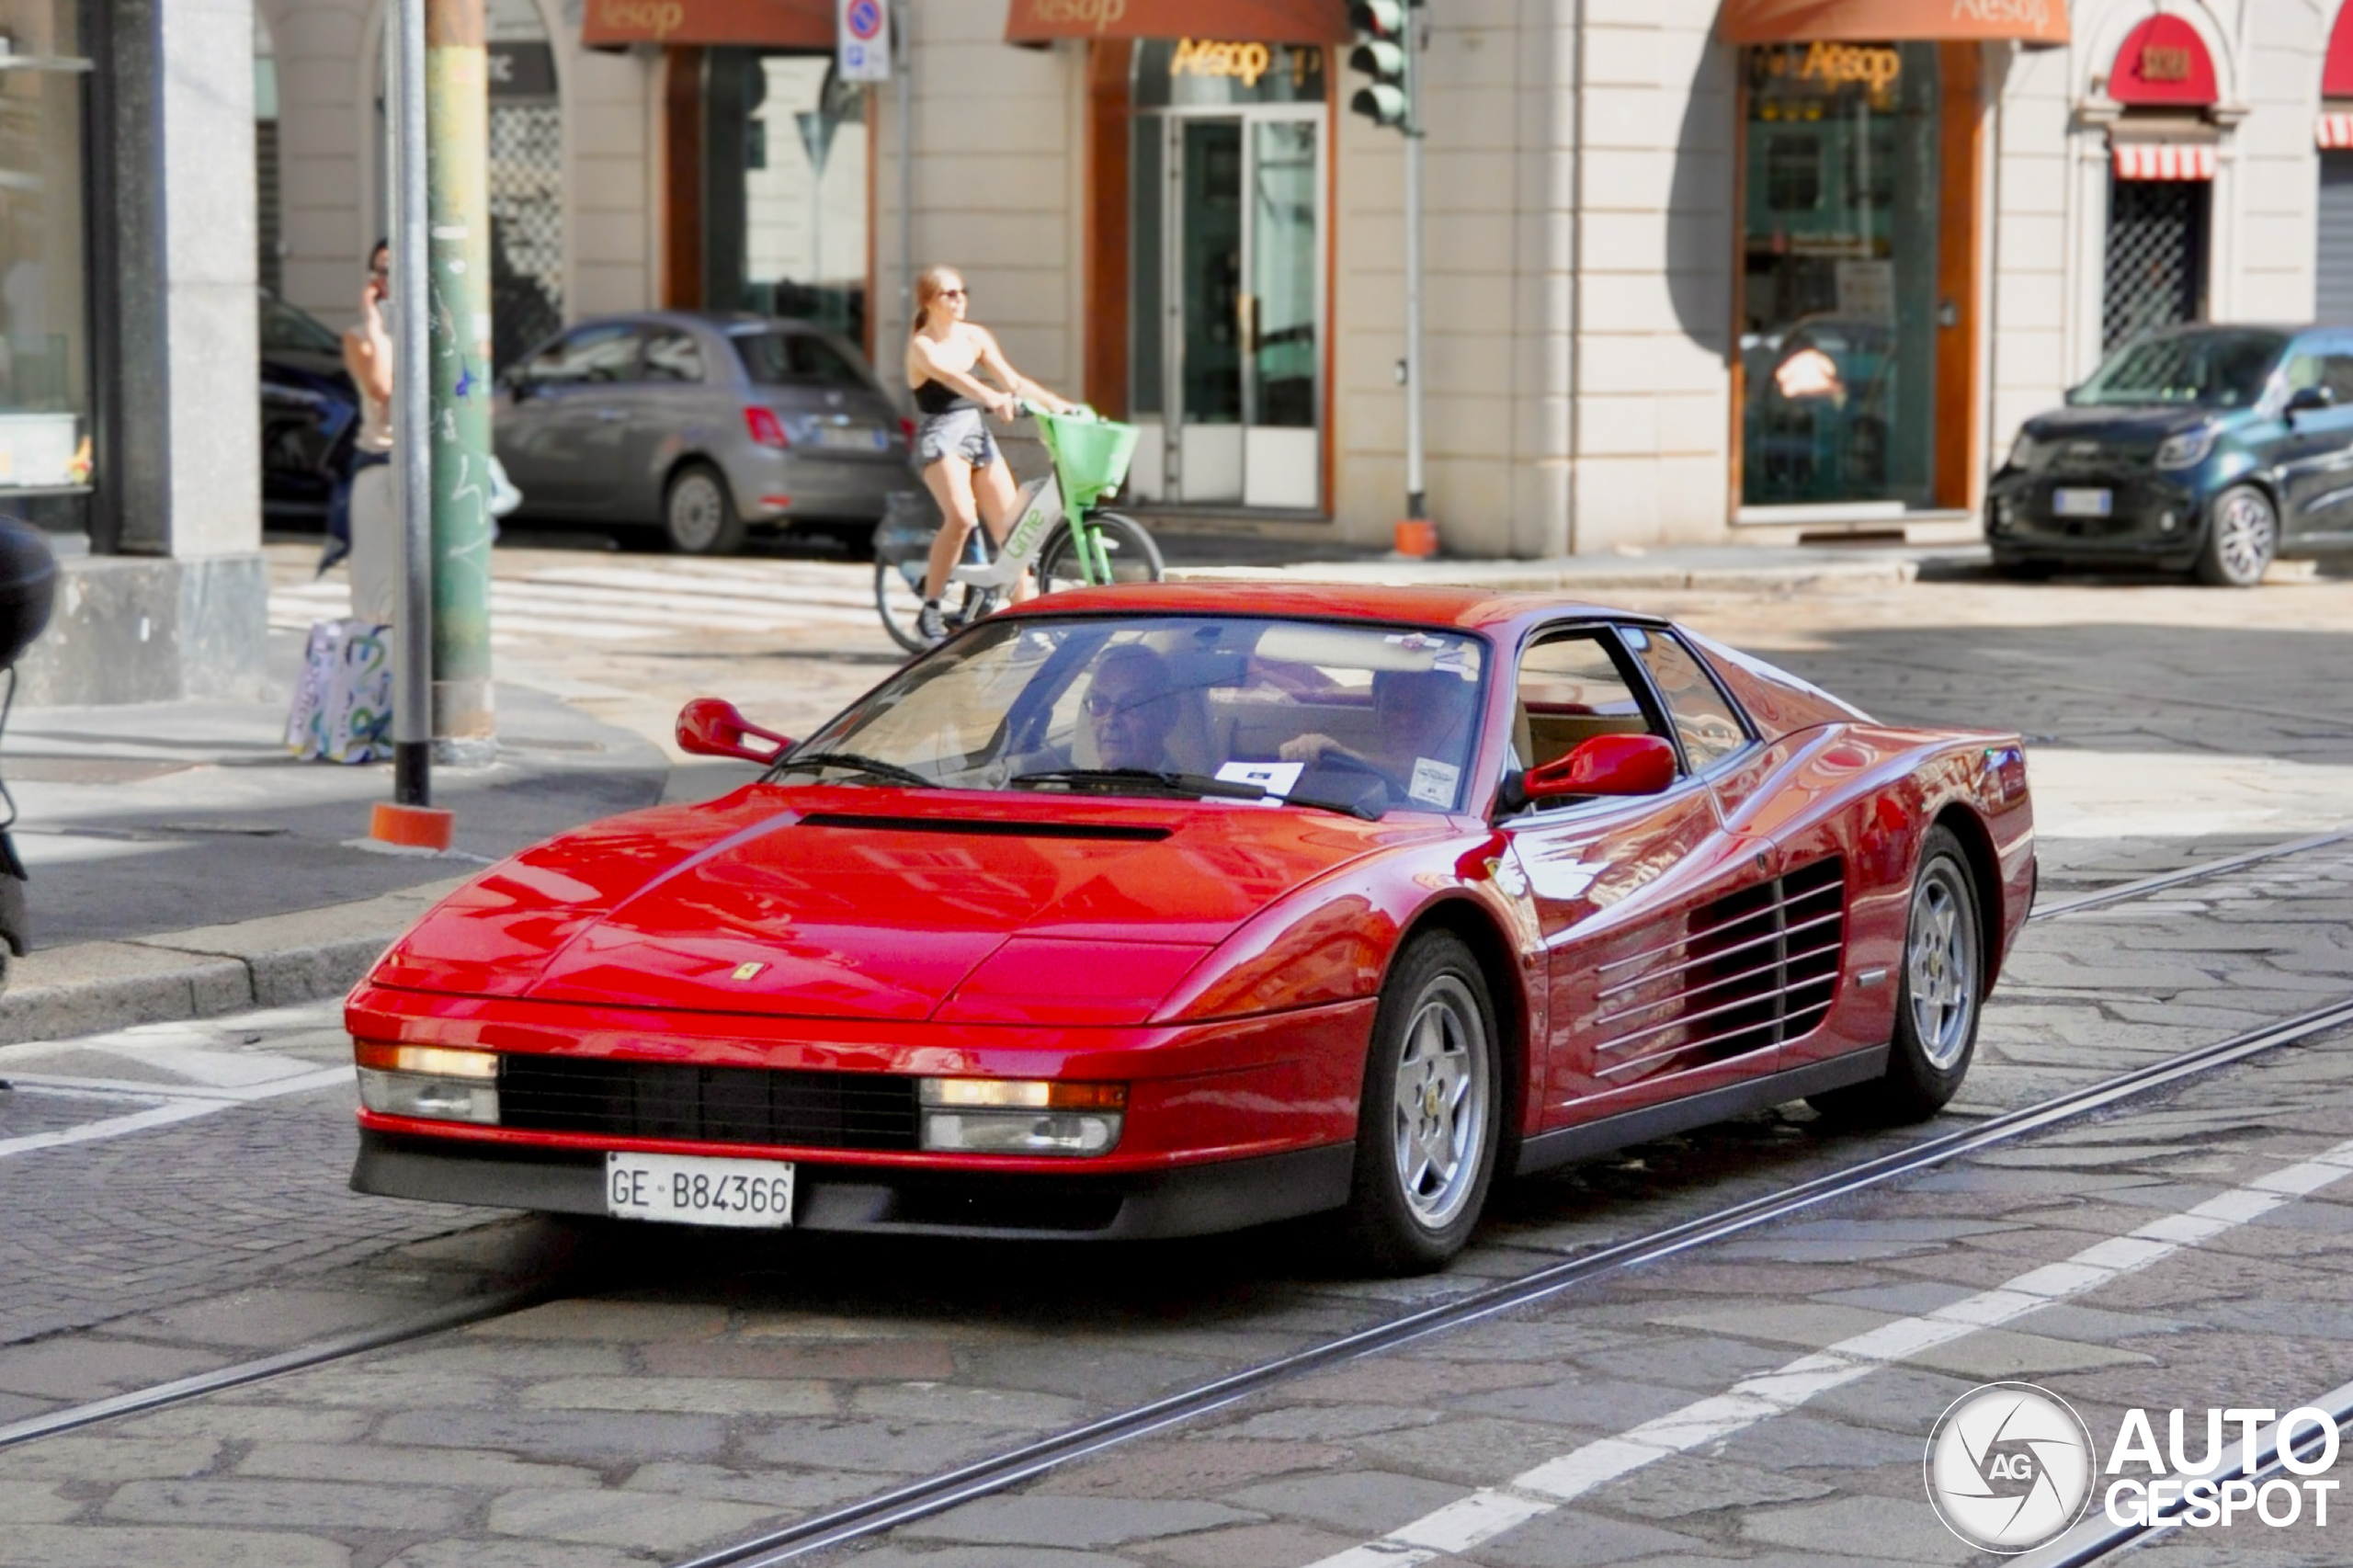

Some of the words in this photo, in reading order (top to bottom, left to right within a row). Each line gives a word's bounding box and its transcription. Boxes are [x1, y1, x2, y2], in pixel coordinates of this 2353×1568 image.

[1169, 37, 1270, 88] Aesop
[1802, 40, 1902, 92] Aesop
[613, 1169, 649, 1207] GE
[674, 1172, 788, 1213] B84366
